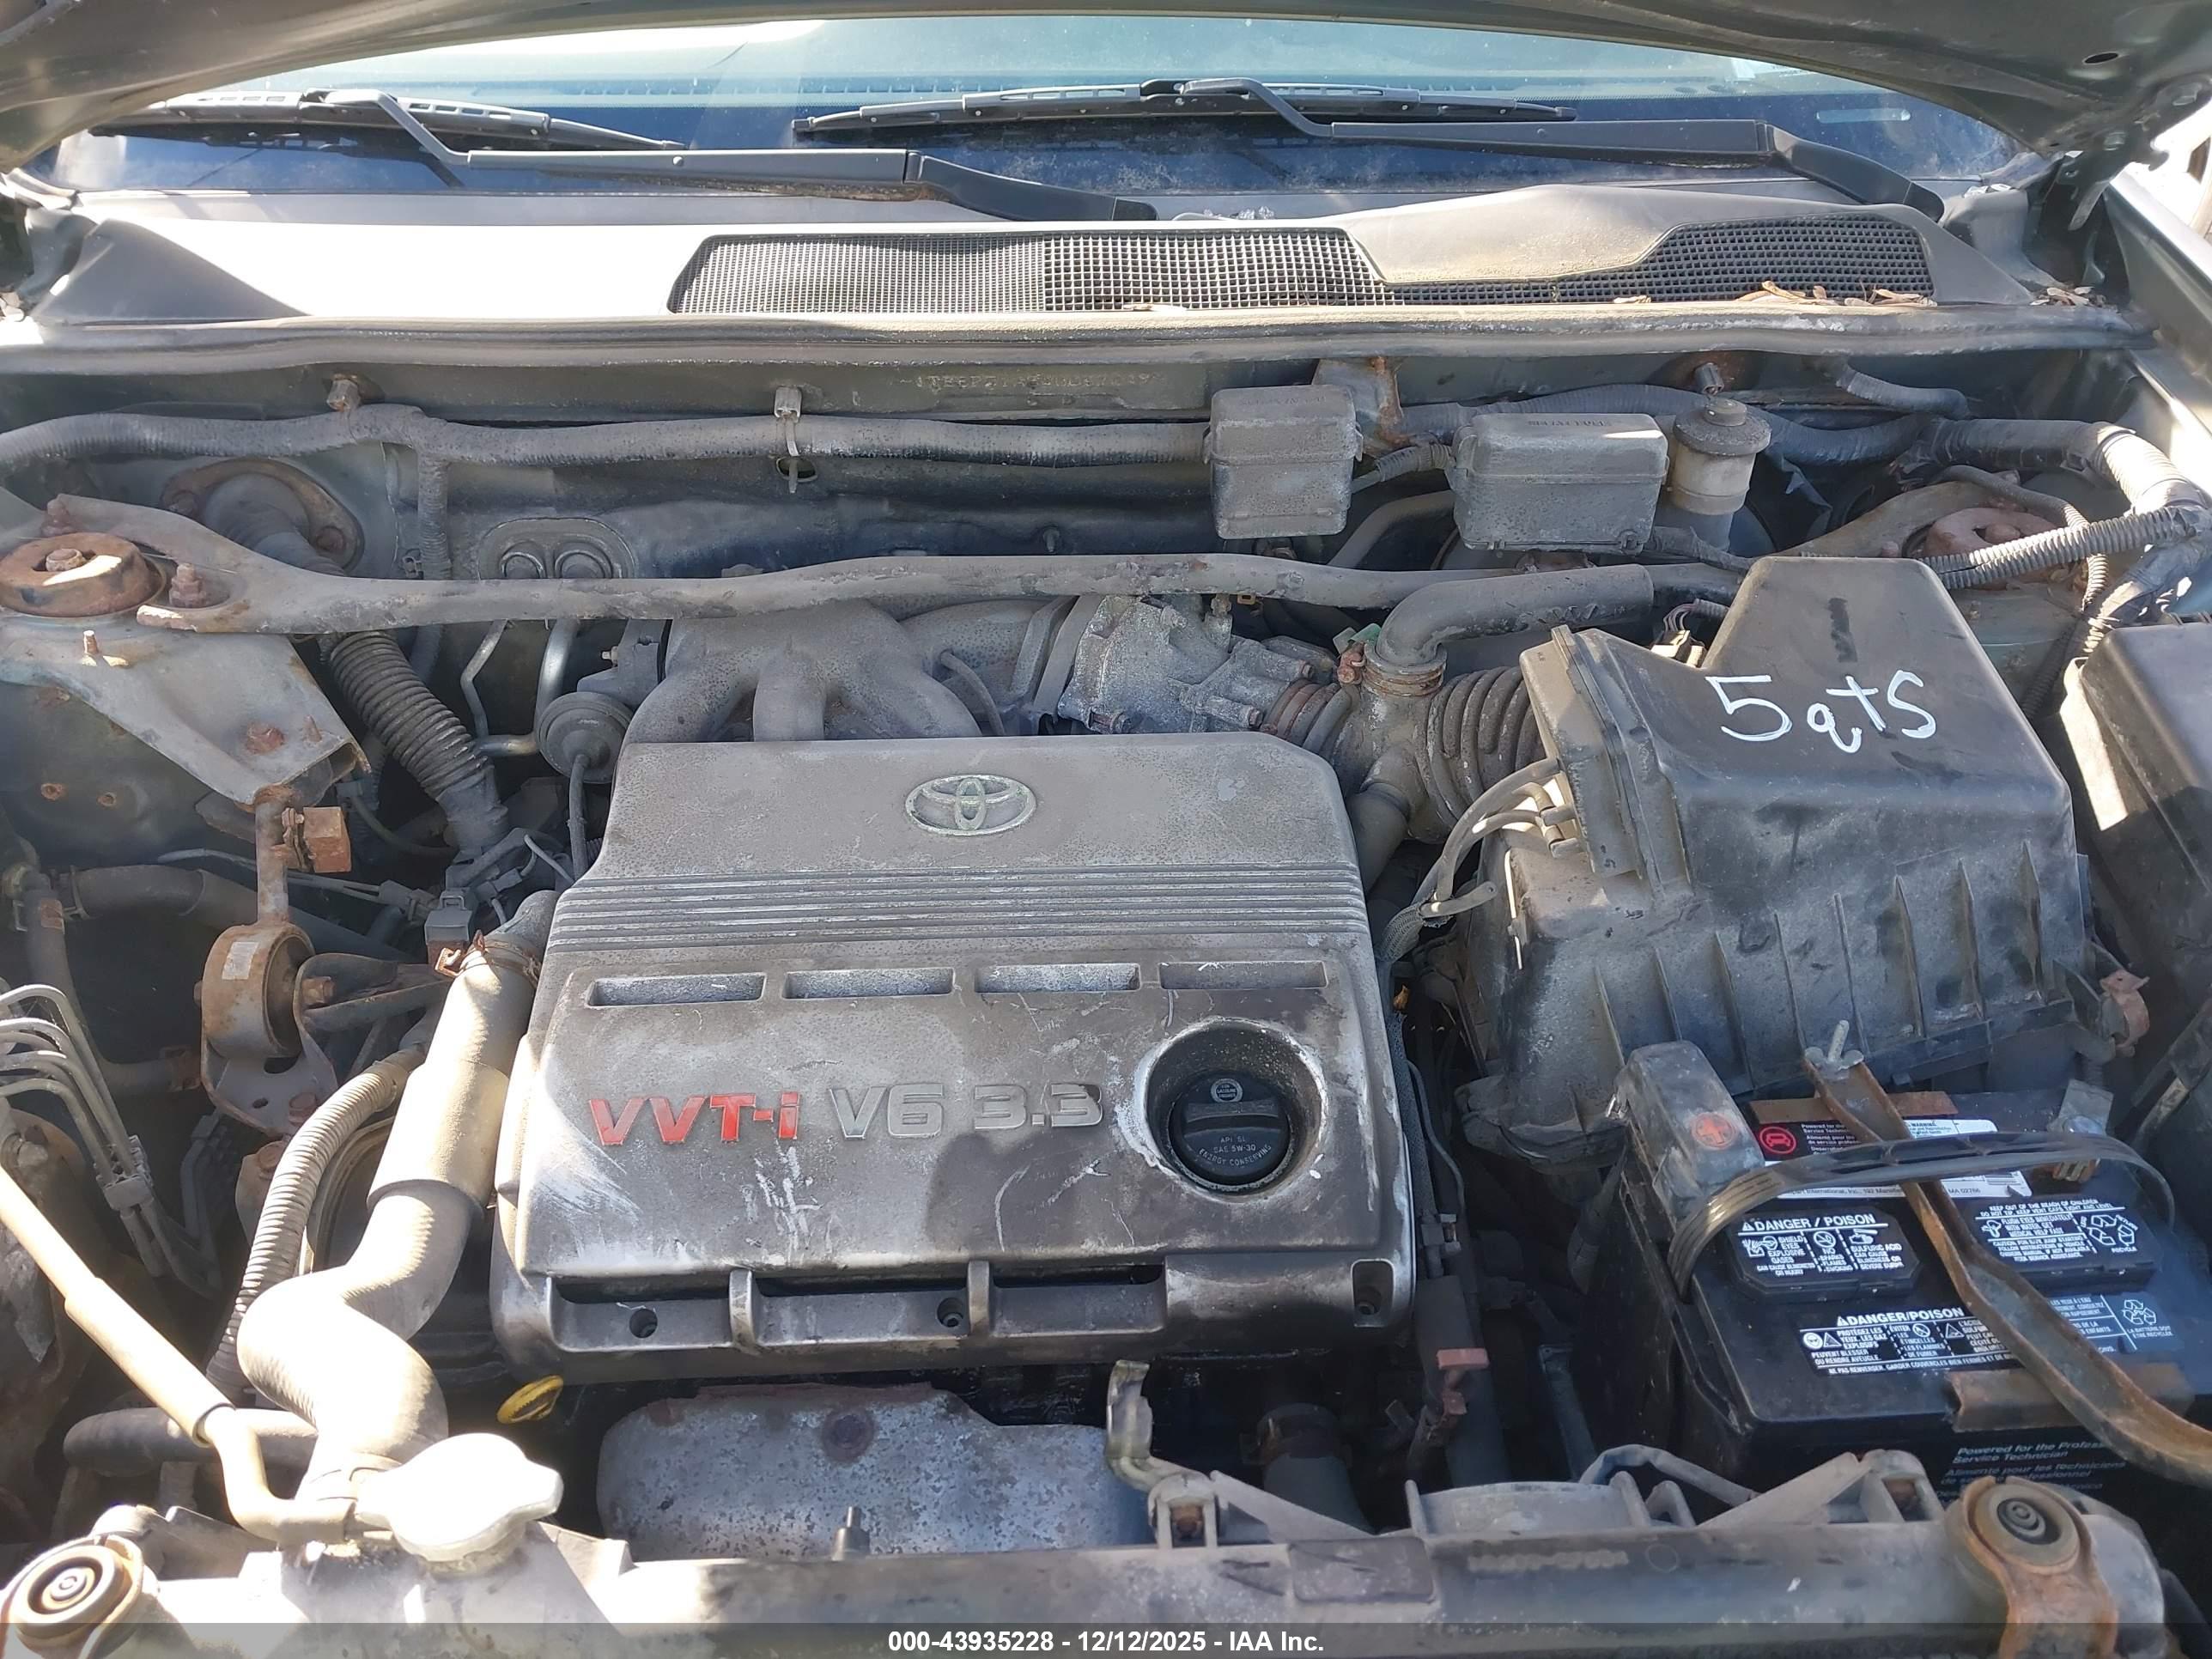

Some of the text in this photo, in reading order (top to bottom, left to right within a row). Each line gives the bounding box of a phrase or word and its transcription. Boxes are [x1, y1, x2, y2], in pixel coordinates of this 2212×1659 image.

[1705, 675, 1793, 742] 5
[589, 1083, 1104, 1146] VVT-i V6 3.3
[1231, 1143, 1256, 1152] 5W-30
[1229, 1143, 1272, 1166] CONSERVING
[1753, 1213, 1876, 1231] DANGER / POISON
[1778, 1235, 1804, 1243] SHIELD
[1780, 1242, 1801, 1250] EYES
[1885, 1243, 1903, 1251] ACID
[1767, 1249, 1806, 1257] EXPLOSIVE
[1846, 1307, 1965, 1327] DANGER/POISON
[1870, 1326, 1884, 1334] LES
[1957, 1446, 2014, 1455] Powered
[2035, 1443, 2056, 1451] the
[1953, 1450, 2069, 1464] Service Technician
[2002, 1465, 2033, 1476] pour
